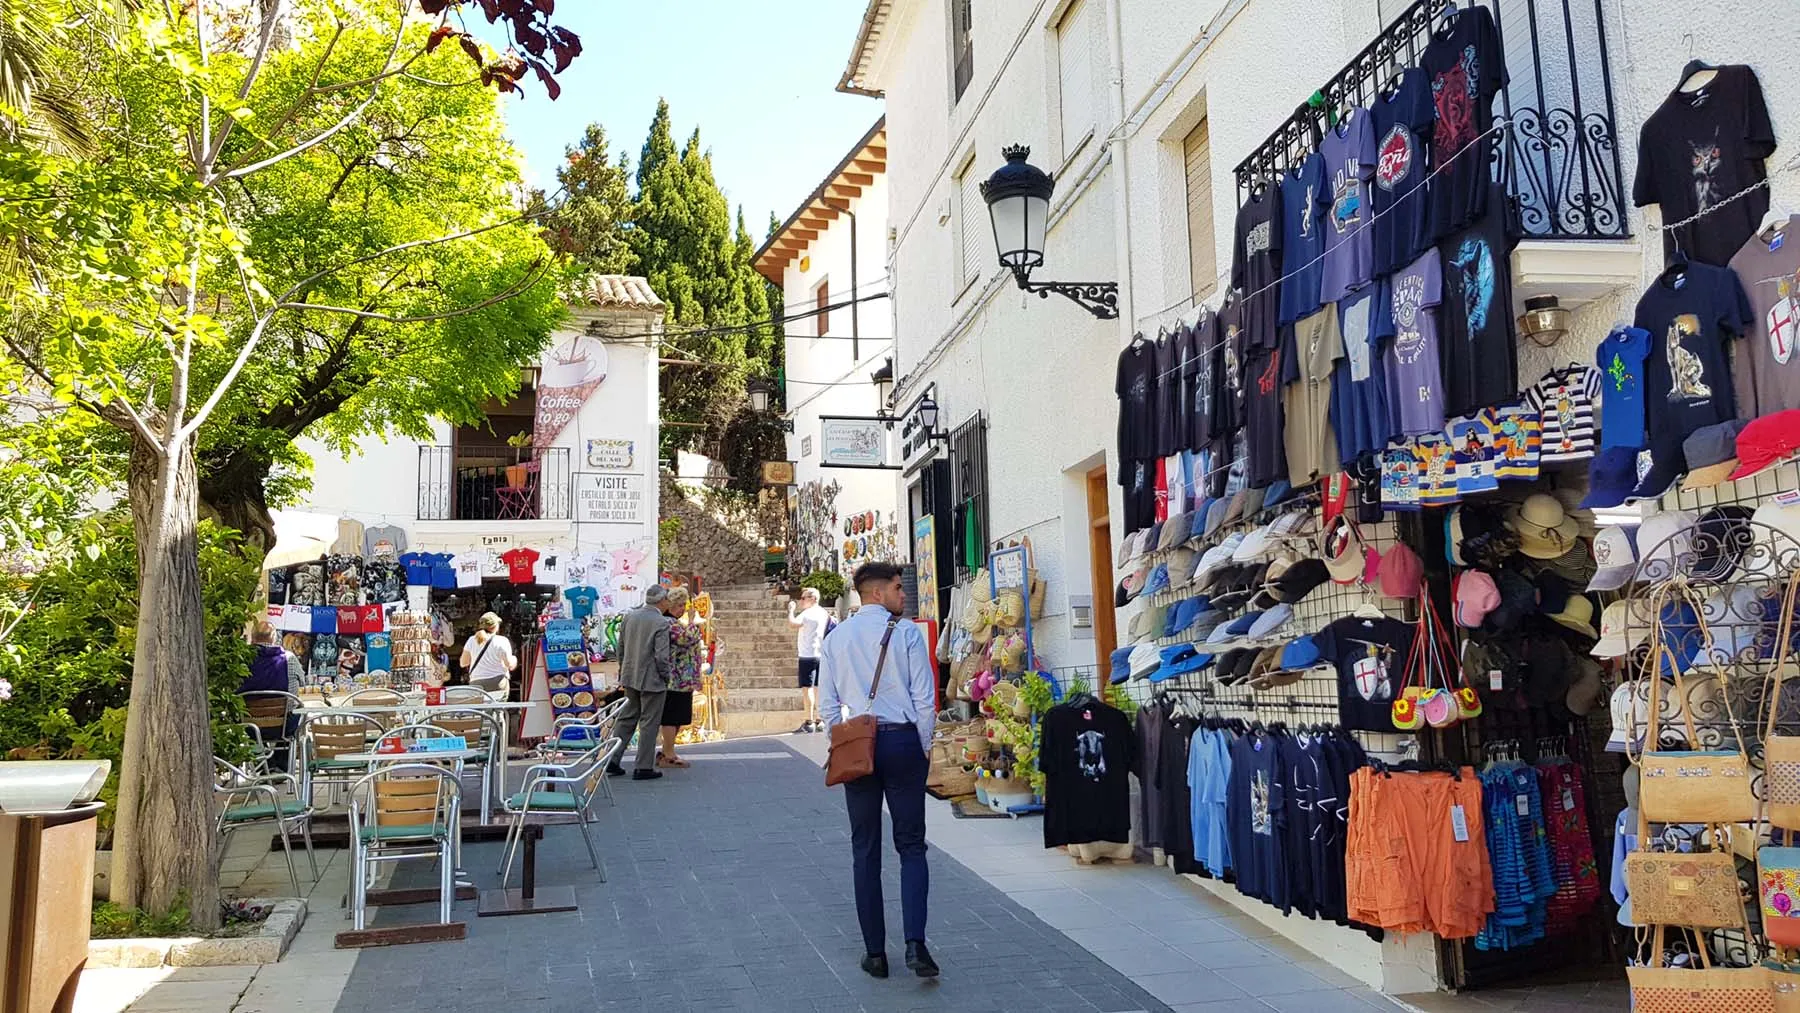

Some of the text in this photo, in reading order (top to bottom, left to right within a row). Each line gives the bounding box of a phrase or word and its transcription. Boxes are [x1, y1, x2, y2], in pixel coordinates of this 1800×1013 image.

[540, 394, 580, 408] Coffee
[539, 411, 569, 426] to go
[595, 477, 628, 489] VISITE
[581, 490, 641, 500] CASTILLO DE SAN JOSE
[588, 500, 612, 509] RETABLO
[613, 500, 628, 510] SIGLO
[611, 511, 626, 520] SIGLO
[482, 537, 507, 545] Tania
[291, 605, 311, 614] FILA
